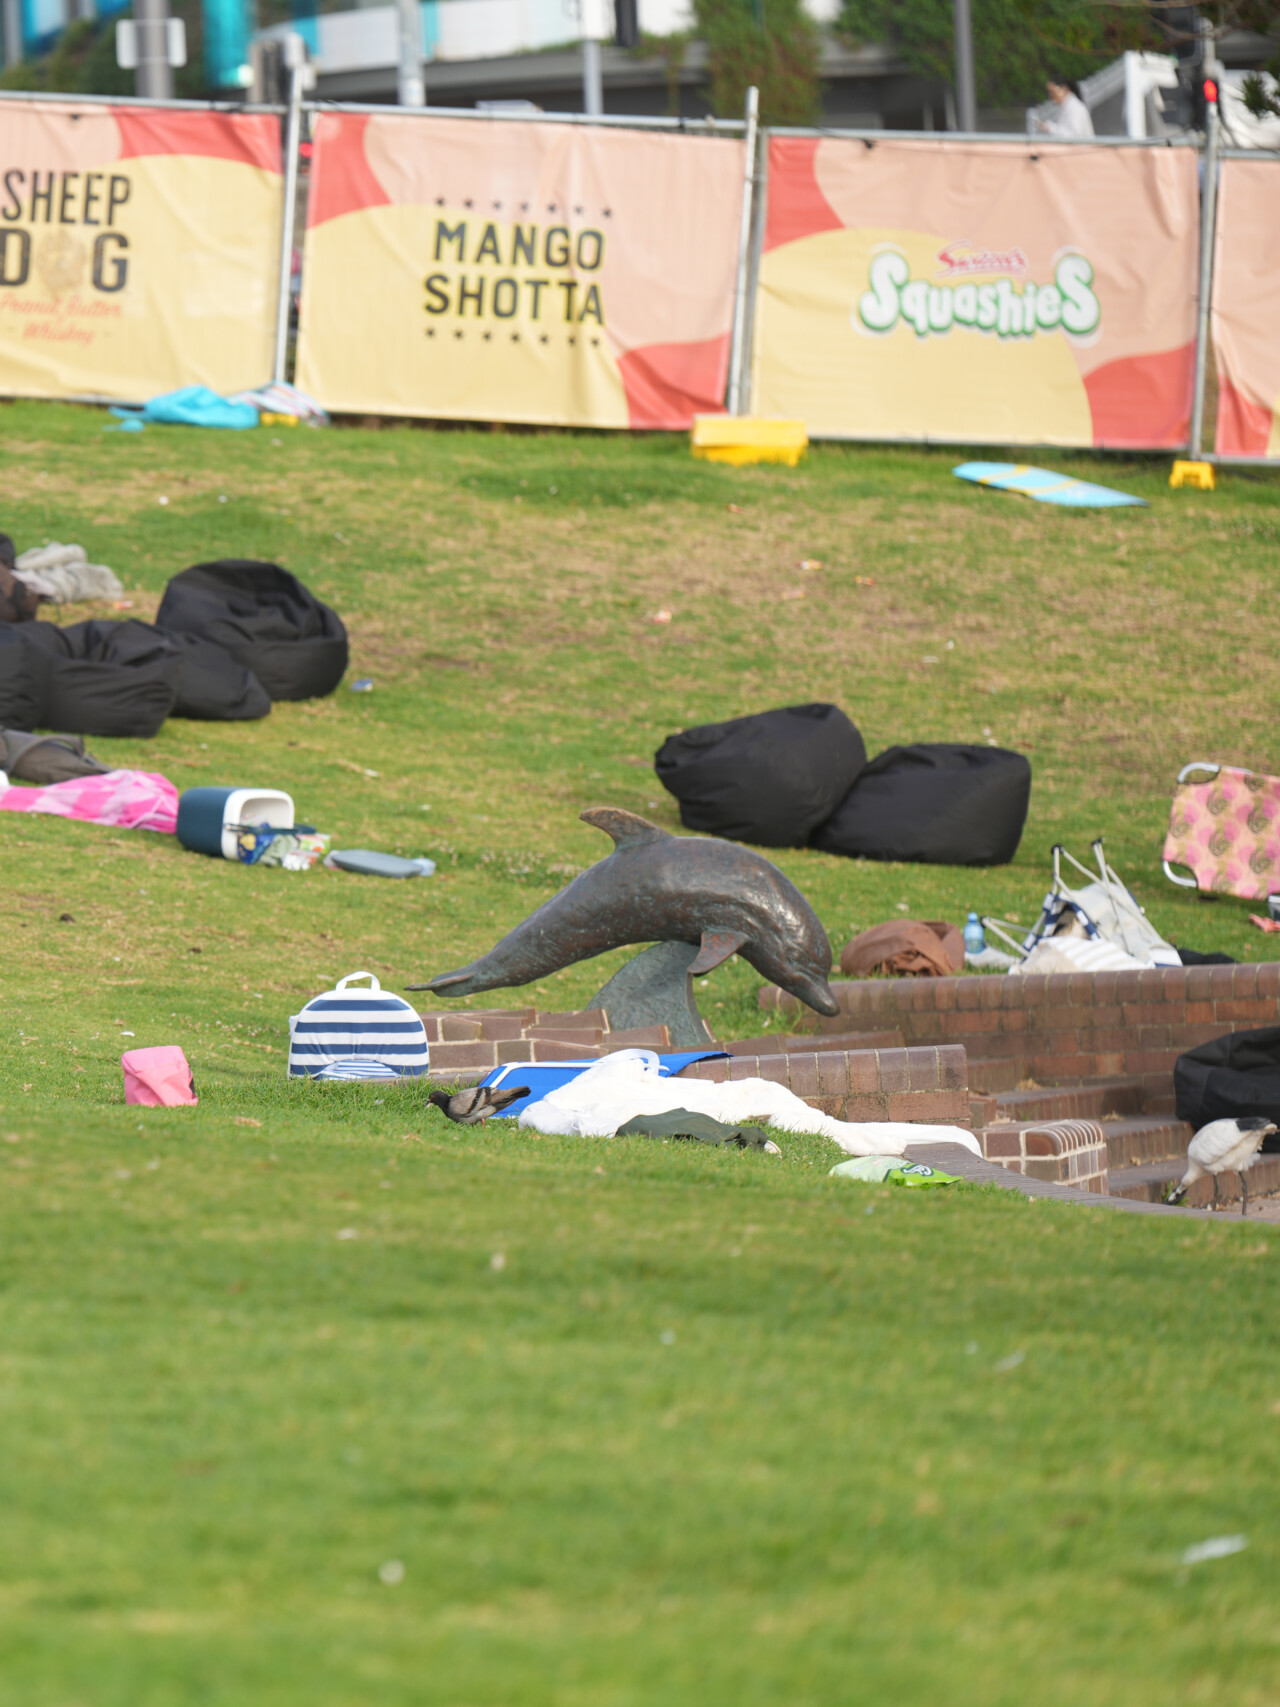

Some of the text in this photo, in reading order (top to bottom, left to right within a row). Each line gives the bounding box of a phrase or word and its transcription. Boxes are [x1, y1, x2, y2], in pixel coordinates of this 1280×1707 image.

[0, 169, 132, 227] SHEEP
[434, 220, 604, 271] MANGO
[424, 274, 604, 325] SHOTTA
